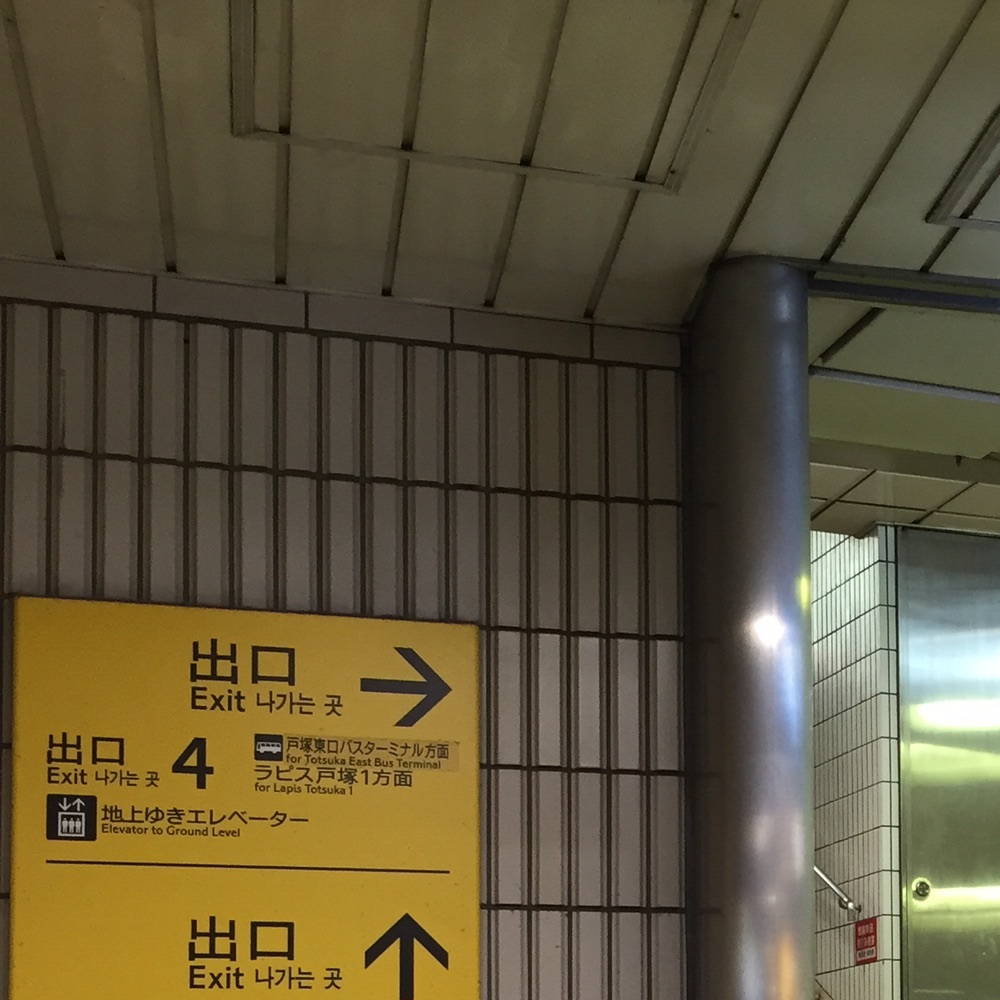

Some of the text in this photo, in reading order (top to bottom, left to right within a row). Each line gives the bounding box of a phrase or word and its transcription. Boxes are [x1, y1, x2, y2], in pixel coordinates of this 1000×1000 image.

[190, 638, 296, 685] 出口
[190, 687, 343, 717] Exit 나가는 곳
[286, 736, 449, 760] 戸塚東口バスターミナル方面
[47, 732, 214, 790] 出口 4
[286, 754, 441, 769] for Totsuka East Bus Terminal
[47, 767, 160, 788] Exit 나가는 곳
[254, 765, 413, 787] ラピス戸塚1方面
[254, 783, 353, 795] for Lapis Totsuka 1
[101, 805, 309, 827] 地上ゆきエレベーター
[102, 824, 241, 838] Elevator to Ground Level
[189, 916, 295, 962] 出口
[189, 965, 343, 991] Exit 나가는 곳
